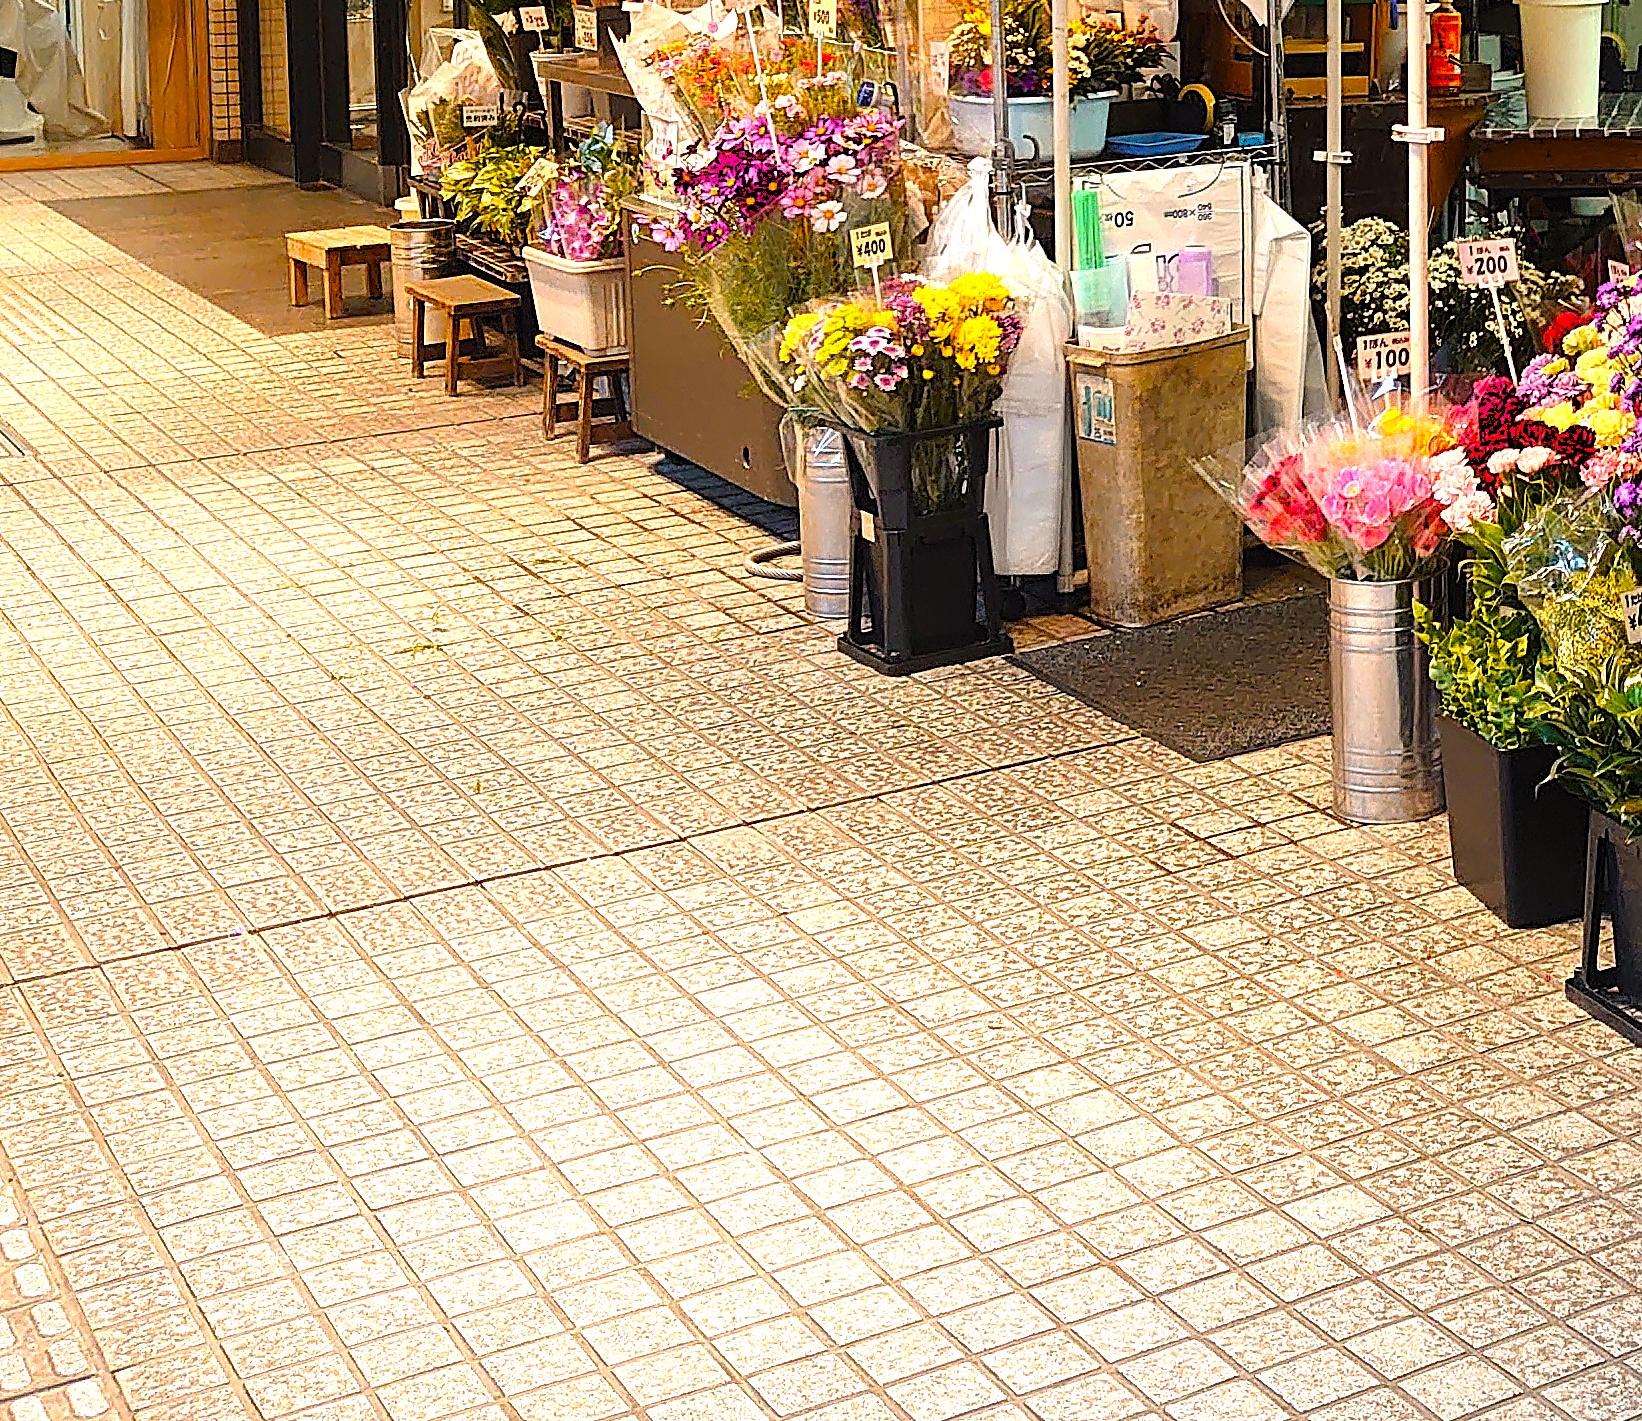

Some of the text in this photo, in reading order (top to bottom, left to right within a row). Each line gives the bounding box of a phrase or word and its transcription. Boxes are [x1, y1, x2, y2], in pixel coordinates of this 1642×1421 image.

[855, 238, 886, 258] ¥400
[1466, 255, 1508, 276] ¥200
[1364, 347, 1410, 370] ¥100
